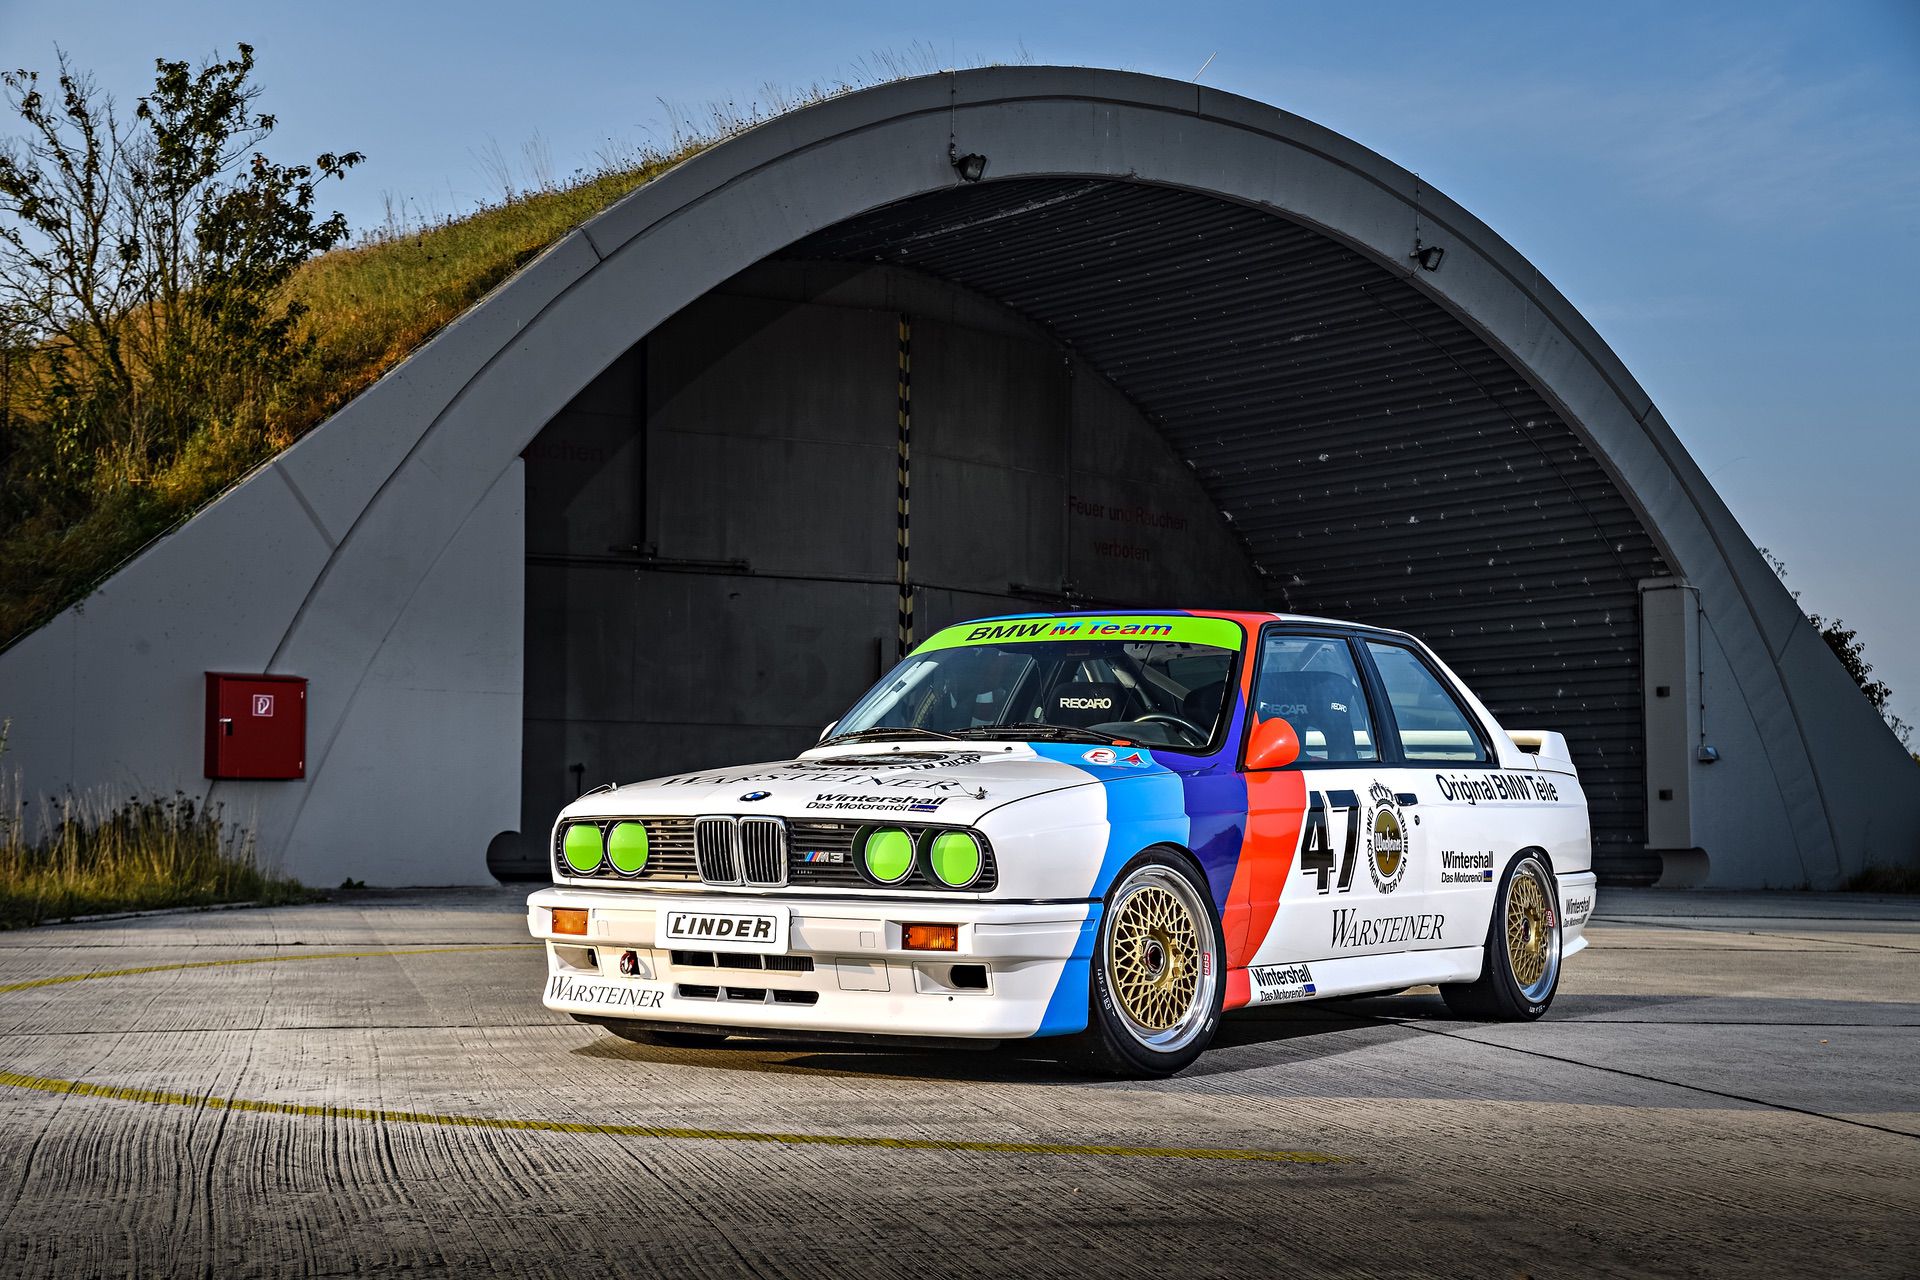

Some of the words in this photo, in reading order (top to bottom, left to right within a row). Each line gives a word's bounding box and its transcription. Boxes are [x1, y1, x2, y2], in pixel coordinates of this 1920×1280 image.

[1068, 495, 1104, 518] Feuer
[1135, 506, 1188, 532] Rauchen
[1094, 541, 1150, 561] verboten
[965, 622, 1051, 641] BMW
[1050, 621, 1082, 636] M
[1088, 621, 1172, 636] Team
[1060, 697, 1112, 709] RECARO
[1331, 702, 1347, 712] RECARO
[659, 772, 960, 791] WARSTEINER
[1436, 774, 1497, 805] Original
[1490, 774, 1531, 800] BMW
[1524, 775, 1559, 801] Teile
[805, 802, 833, 810] Das
[834, 802, 909, 812] Motorenöl
[815, 793, 949, 806] Wintershall
[1301, 789, 1362, 895] 47
[815, 851, 844, 863] M3
[1441, 850, 1493, 869] Wintershall
[1441, 871, 1454, 883] Das
[1454, 871, 1483, 883] Motorenöl
[672, 916, 772, 938] LINDER
[1331, 907, 1445, 949] WARSTEINER
[1251, 964, 1313, 987] Wintershall
[549, 975, 665, 1008] WARSTEINER
[1260, 990, 1273, 1002] Das
[1273, 987, 1305, 1000] Motorenöl
